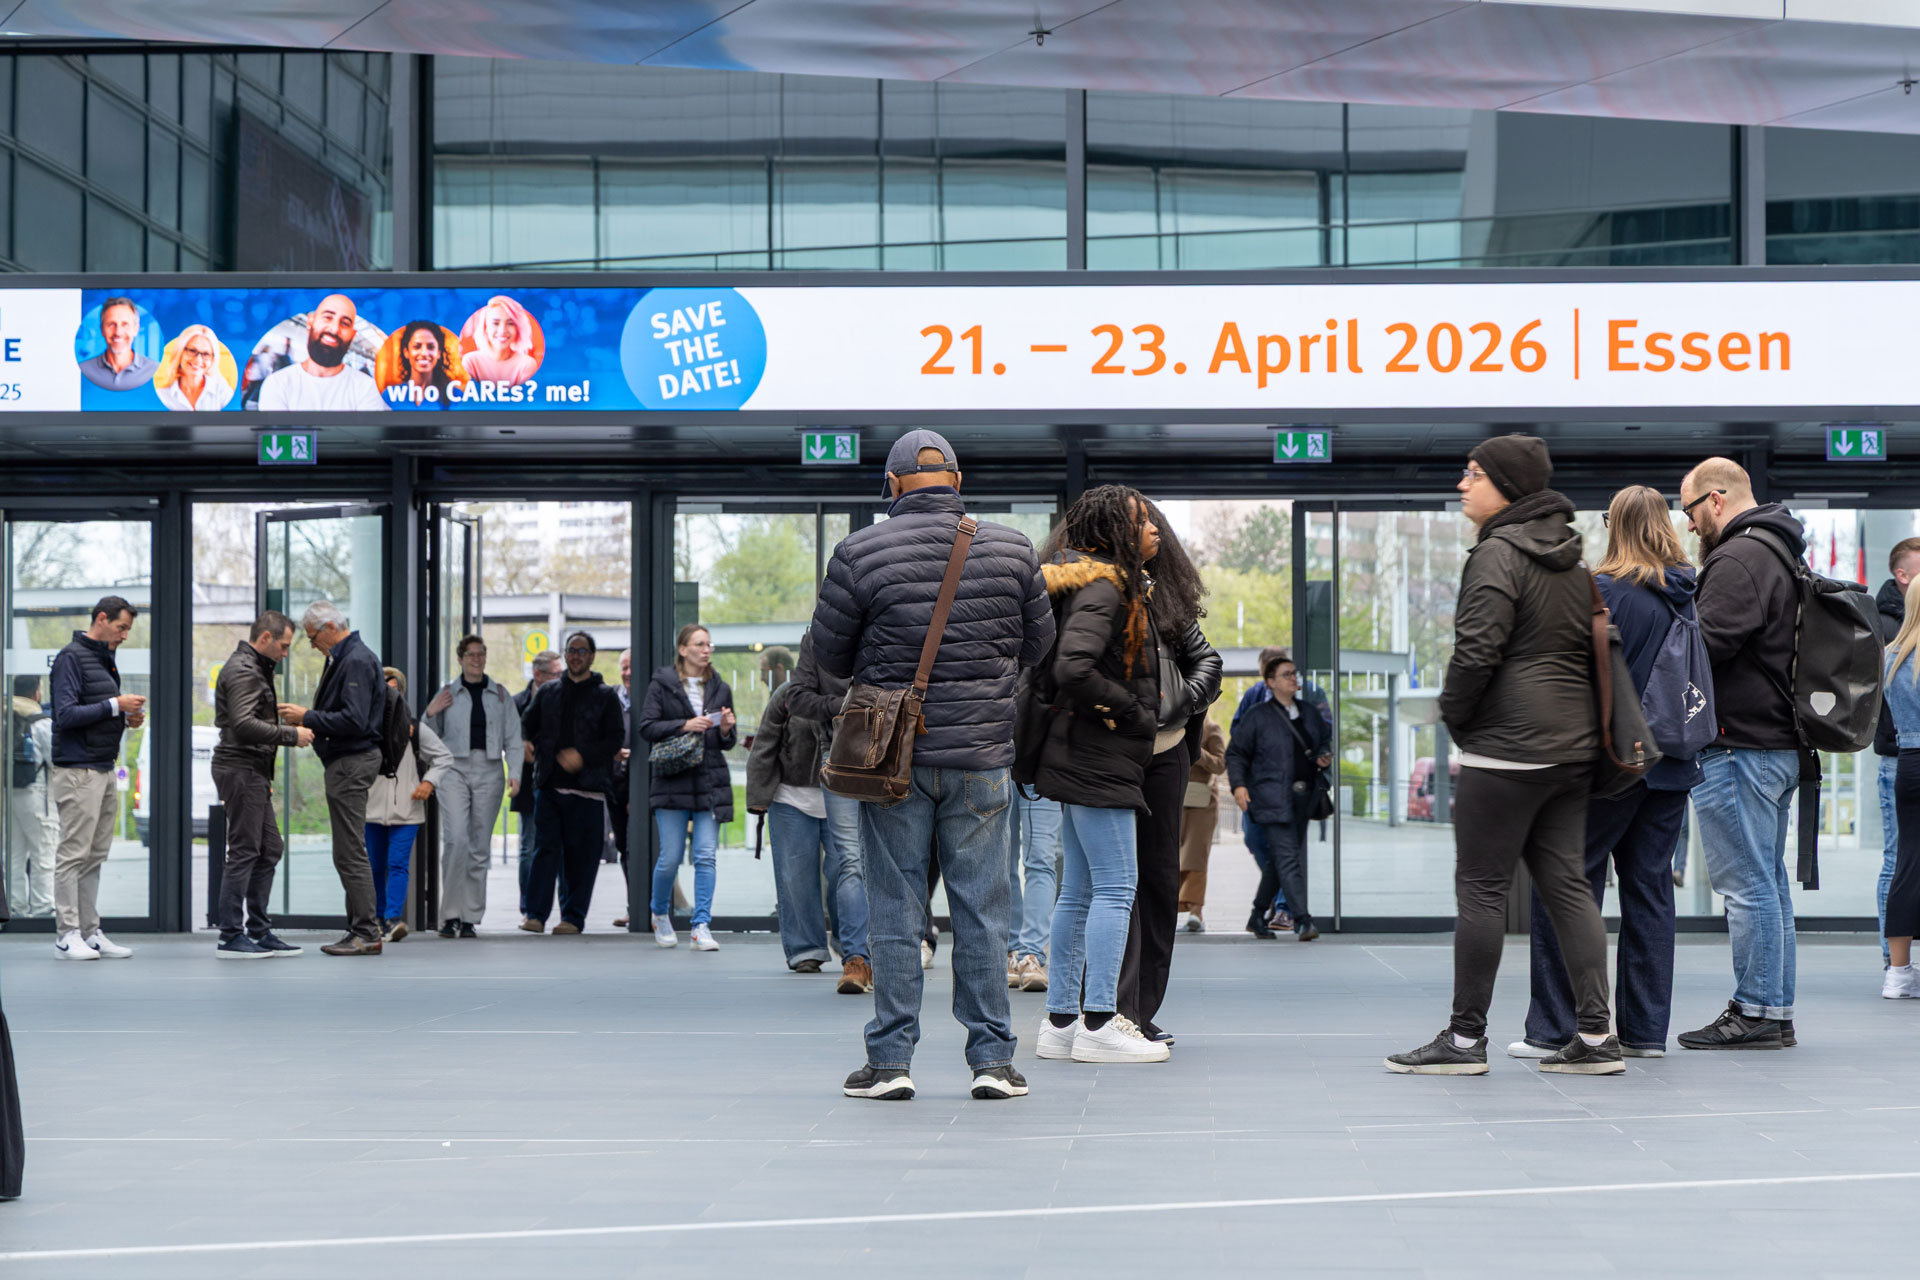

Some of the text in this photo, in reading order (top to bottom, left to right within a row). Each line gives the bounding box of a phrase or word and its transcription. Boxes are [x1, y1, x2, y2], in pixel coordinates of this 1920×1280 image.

[651, 300, 727, 339] SAVE
[664, 332, 723, 367] THE
[919, 324, 1007, 376] 21.
[1090, 323, 1187, 377] 23.
[1207, 317, 1364, 390] April
[1384, 319, 1547, 374] 2026
[1607, 319, 1791, 373] Essen
[387, 380, 590, 403] who CAREs? me!
[658, 359, 742, 400] DATE!
